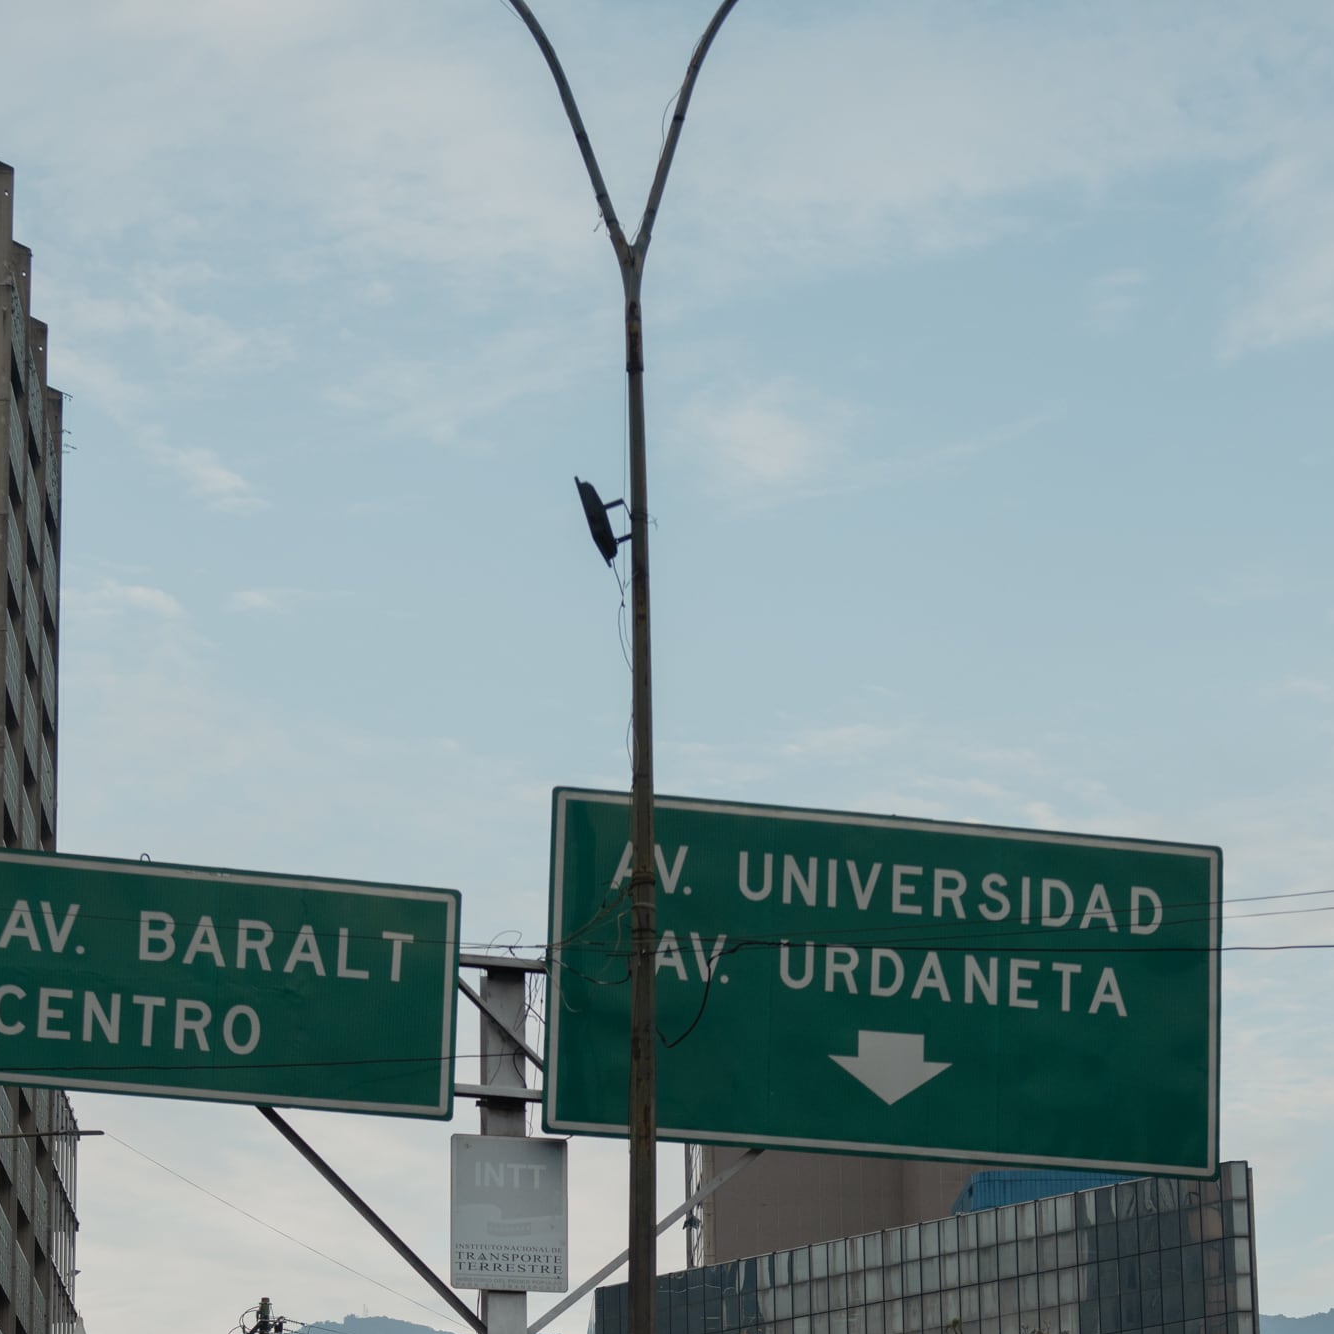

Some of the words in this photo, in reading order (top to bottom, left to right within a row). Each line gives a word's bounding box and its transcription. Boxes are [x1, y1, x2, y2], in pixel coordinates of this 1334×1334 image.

[738, 851, 1163, 936] UNIVERSIDAD
[139, 911, 415, 983] BARALT
[655, 930, 729, 985] AV.
[780, 940, 1128, 1018] URDANETA
[475, 1161, 547, 1189] INTT
[454, 1262, 563, 1275] TERRESTRE
[455, 1251, 562, 1265] TRANSPORTE
